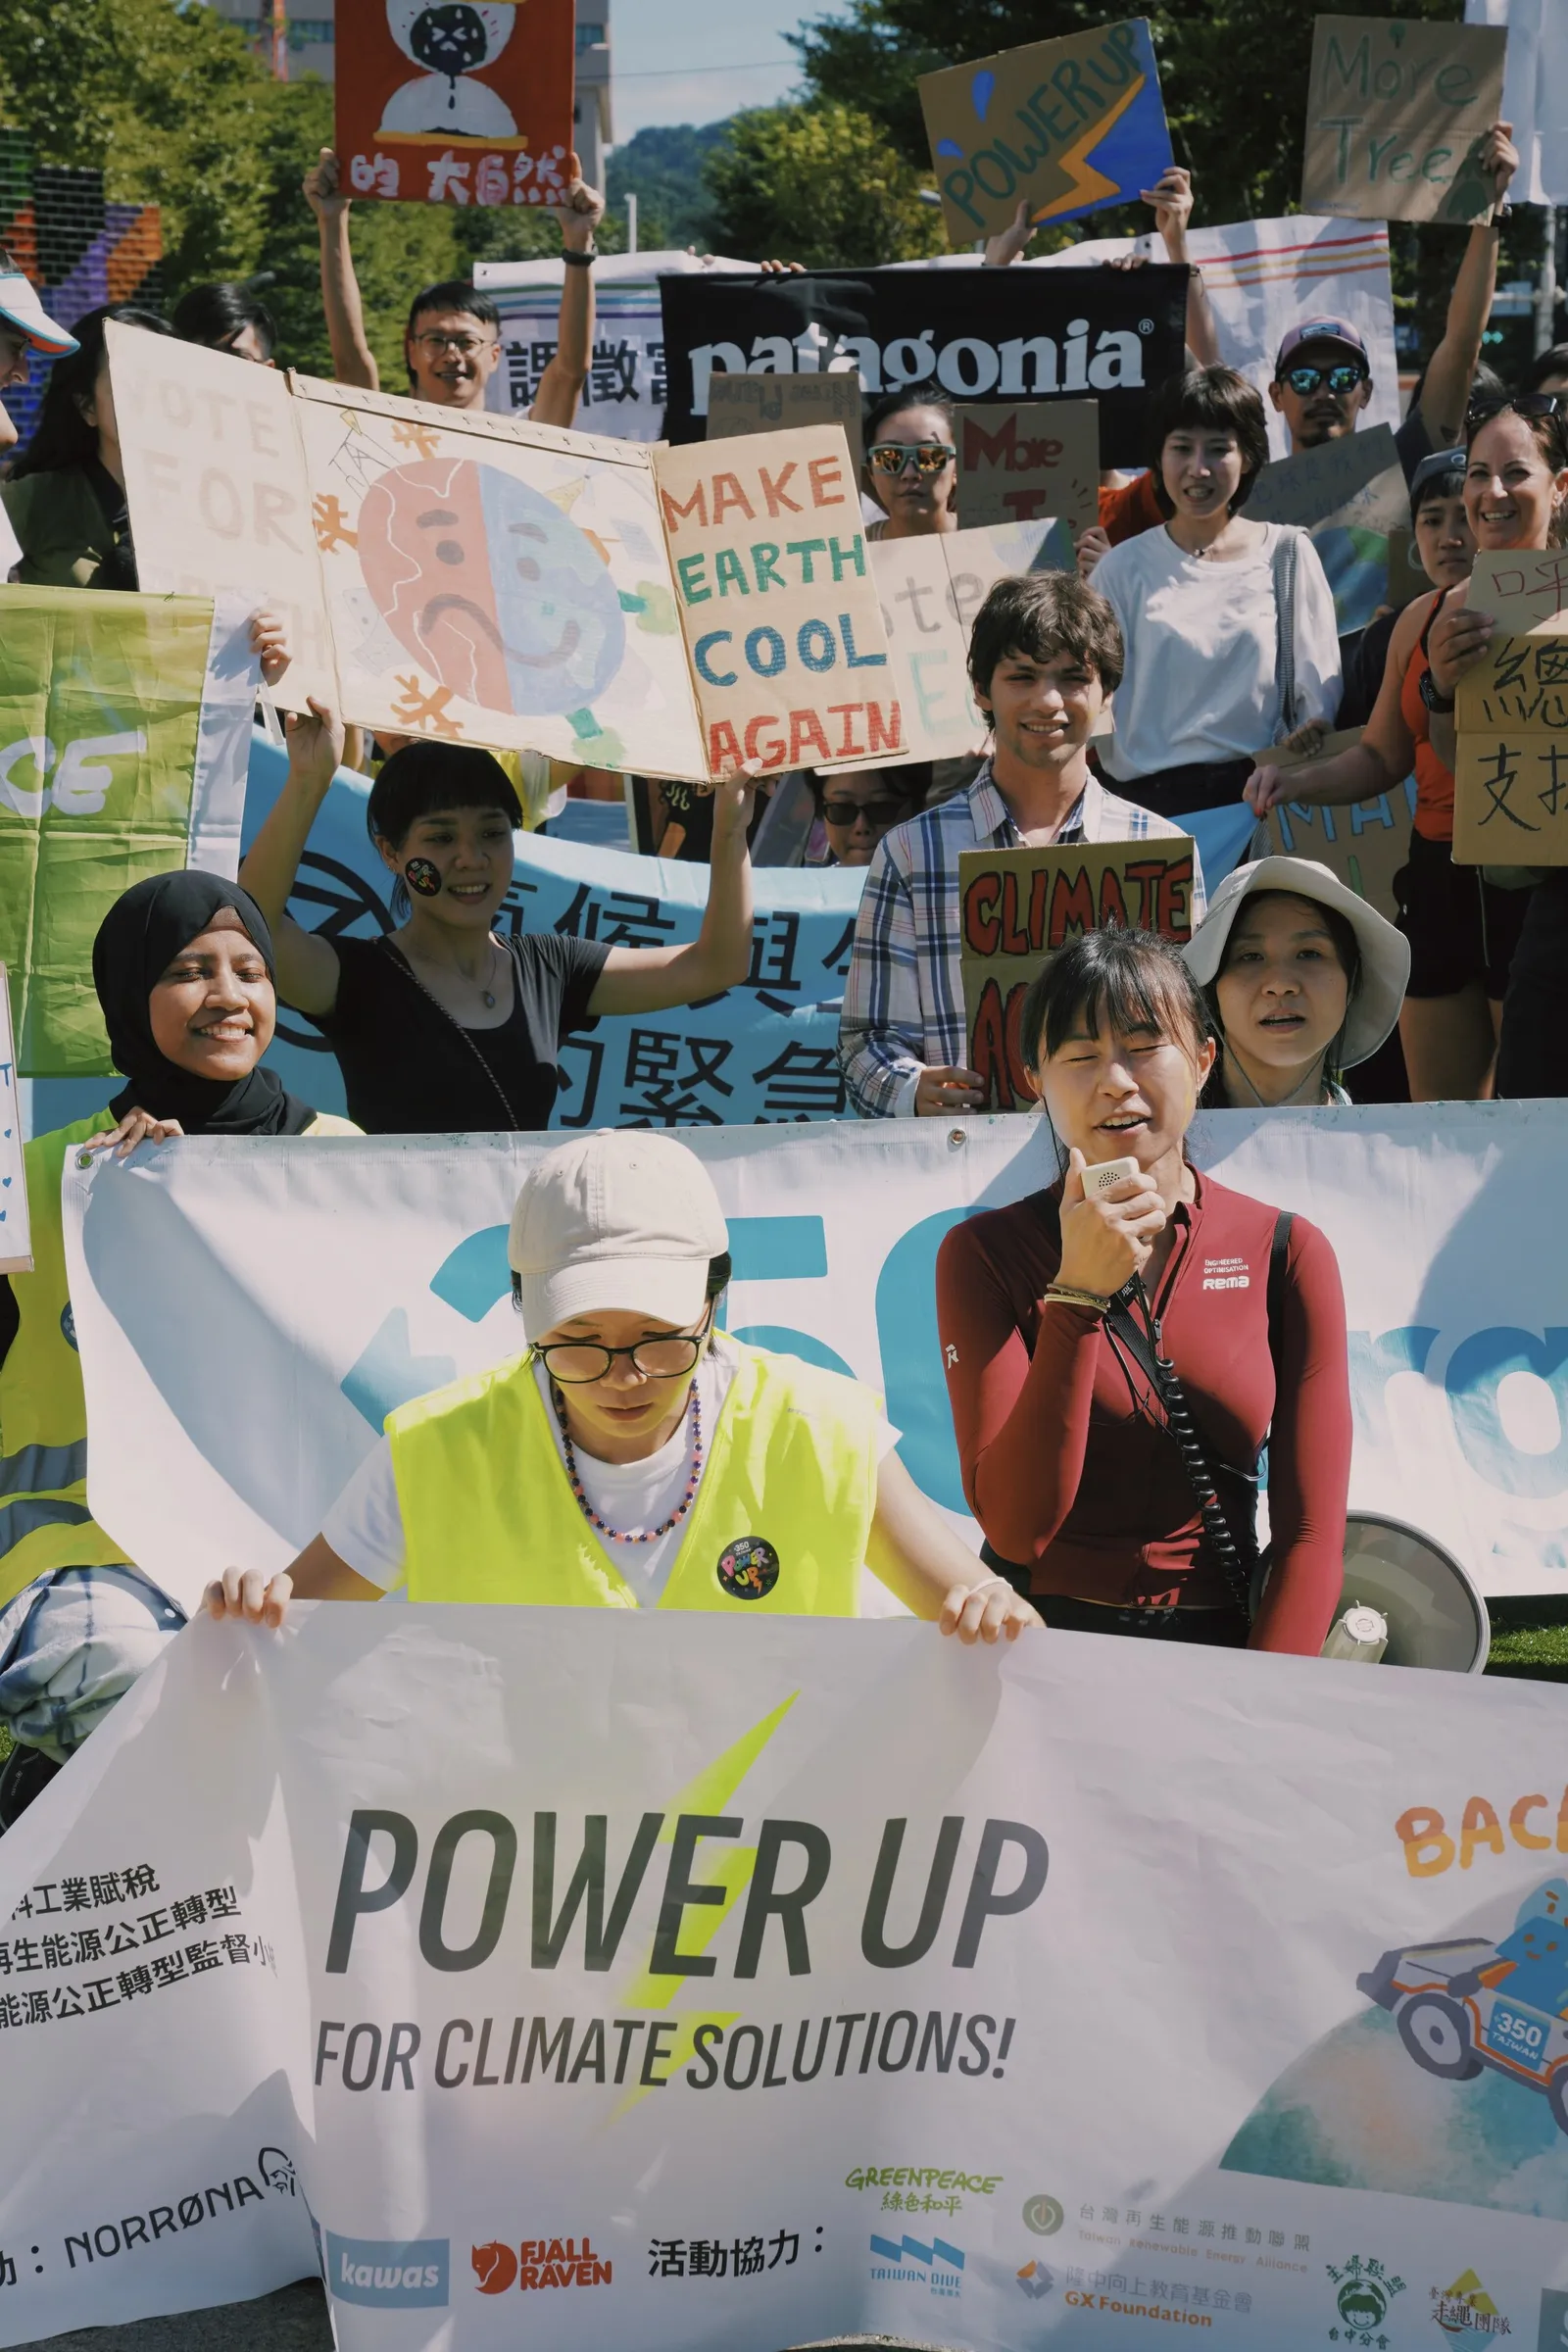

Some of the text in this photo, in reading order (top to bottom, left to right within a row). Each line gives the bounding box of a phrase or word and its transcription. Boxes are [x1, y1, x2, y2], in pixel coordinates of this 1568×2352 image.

[1322, 33, 1479, 107] More
[944, 23, 1143, 229] POWER UP
[962, 412, 1064, 472] More
[141, 449, 304, 555] FOR
[659, 455, 846, 534] MAKE
[677, 533, 867, 608] EARTH
[694, 613, 887, 687] COOL
[708, 699, 903, 776] AGAIN
[963, 855, 1194, 956] CLIMATE
[324, 1809, 1051, 1980] POWER UP
[0, 1933, 279, 2029] 能源公正轉型監督小
[315, 2009, 1016, 2091] FOR CLIMATE SOLUTIONS!
[1492, 2031, 1540, 2061] TAIWAN
[1496, 2012, 1544, 2047] 350
[845, 2166, 1004, 2195] GREENPEACE
[880, 2190, 963, 2218] 綠色和平
[64, 2175, 266, 2270] NORRØNA
[1077, 2229, 1309, 2274] Taiwan Renewable Energy Alliance
[1079, 2202, 1311, 2253] 台灣再生能源推動聯盟
[340, 2252, 440, 2290] kawas
[869, 2268, 962, 2289] TAIWAN DIVE
[1064, 2289, 1213, 2328] GX Foundation
